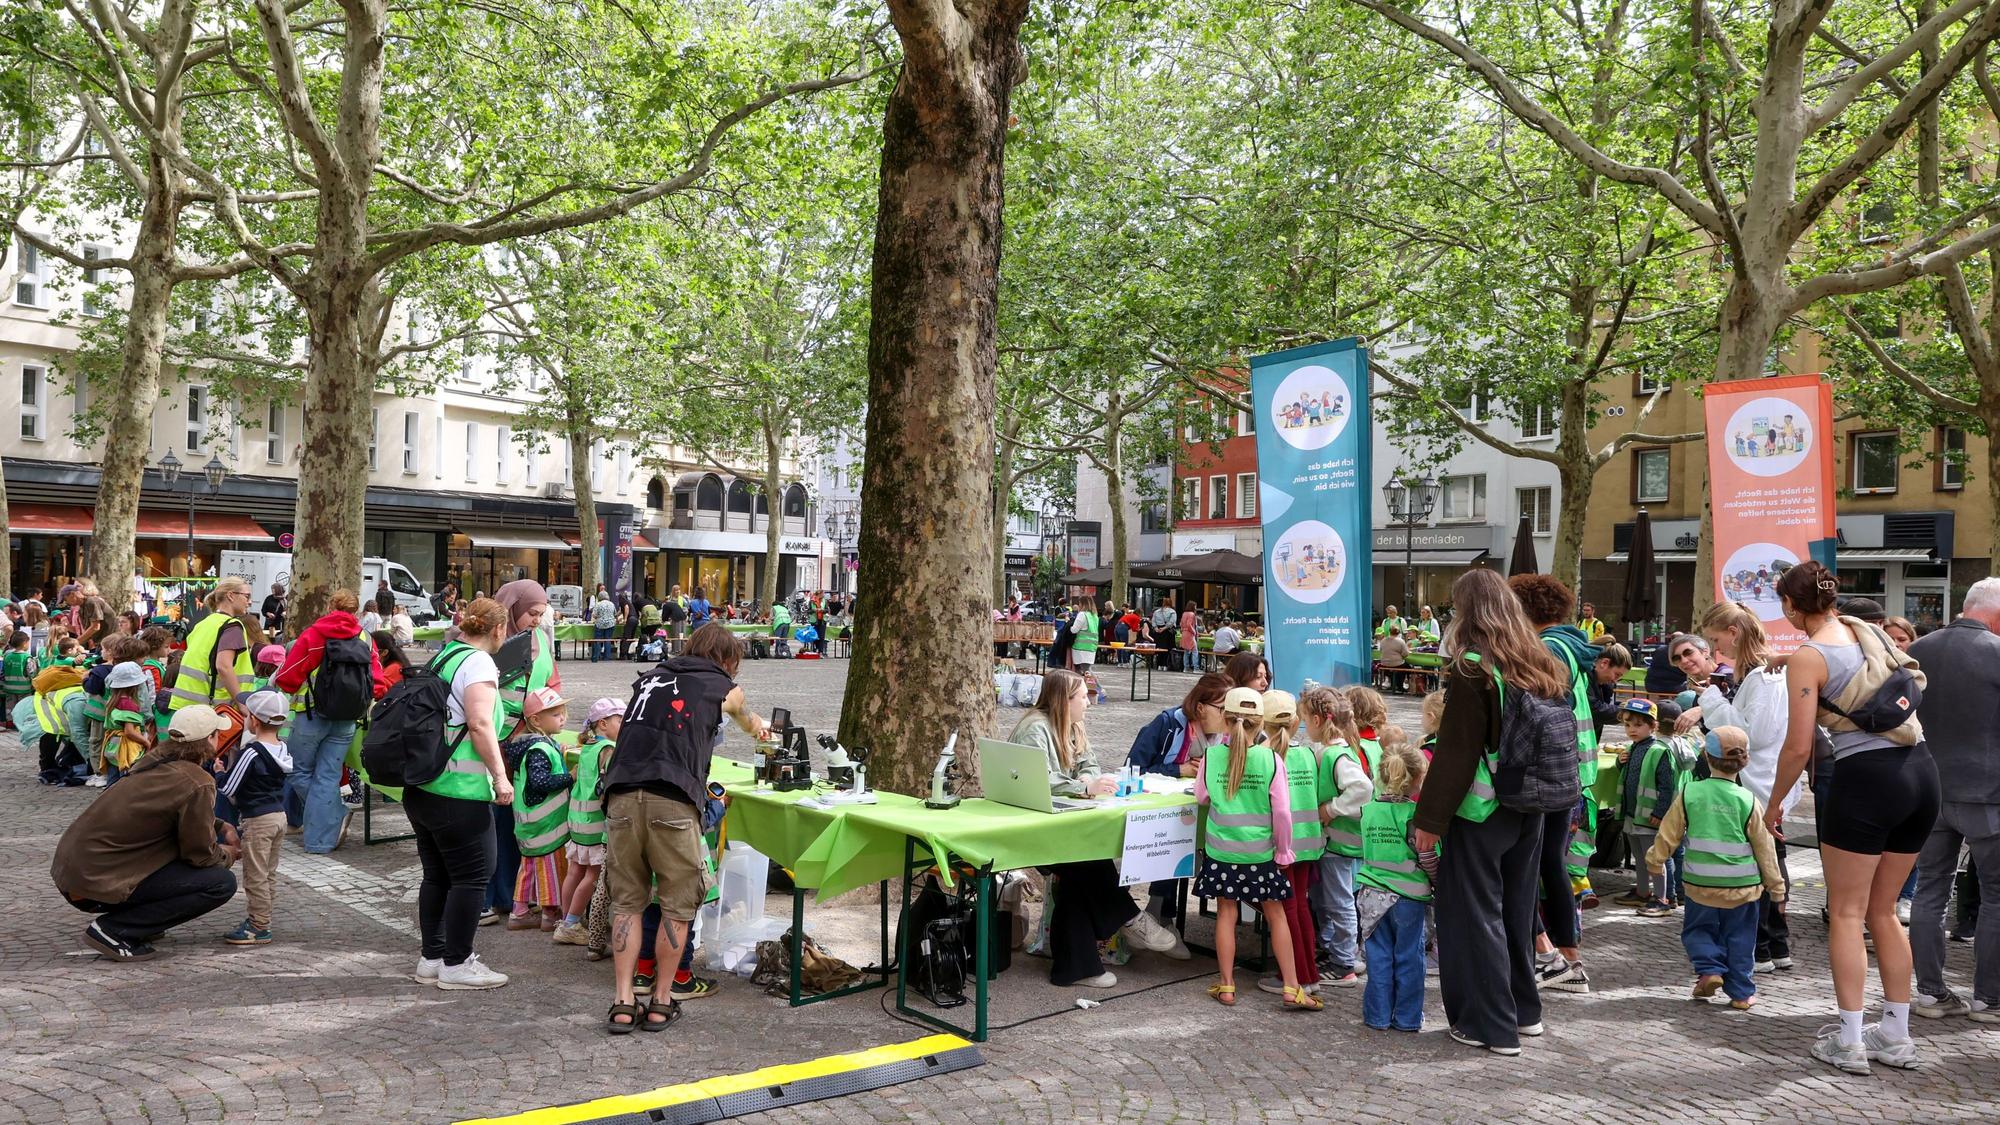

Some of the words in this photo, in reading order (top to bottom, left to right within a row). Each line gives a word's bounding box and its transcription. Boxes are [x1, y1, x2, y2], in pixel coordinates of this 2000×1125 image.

[1376, 535, 1393, 545] der
[1395, 534, 1465, 545] blumenladen
[1130, 813, 1156, 823] Längster
[1157, 808, 1194, 820] Forschertisch
[1125, 843, 1154, 851] Kindergarten
[1158, 838, 1193, 847] Familienzentrum
